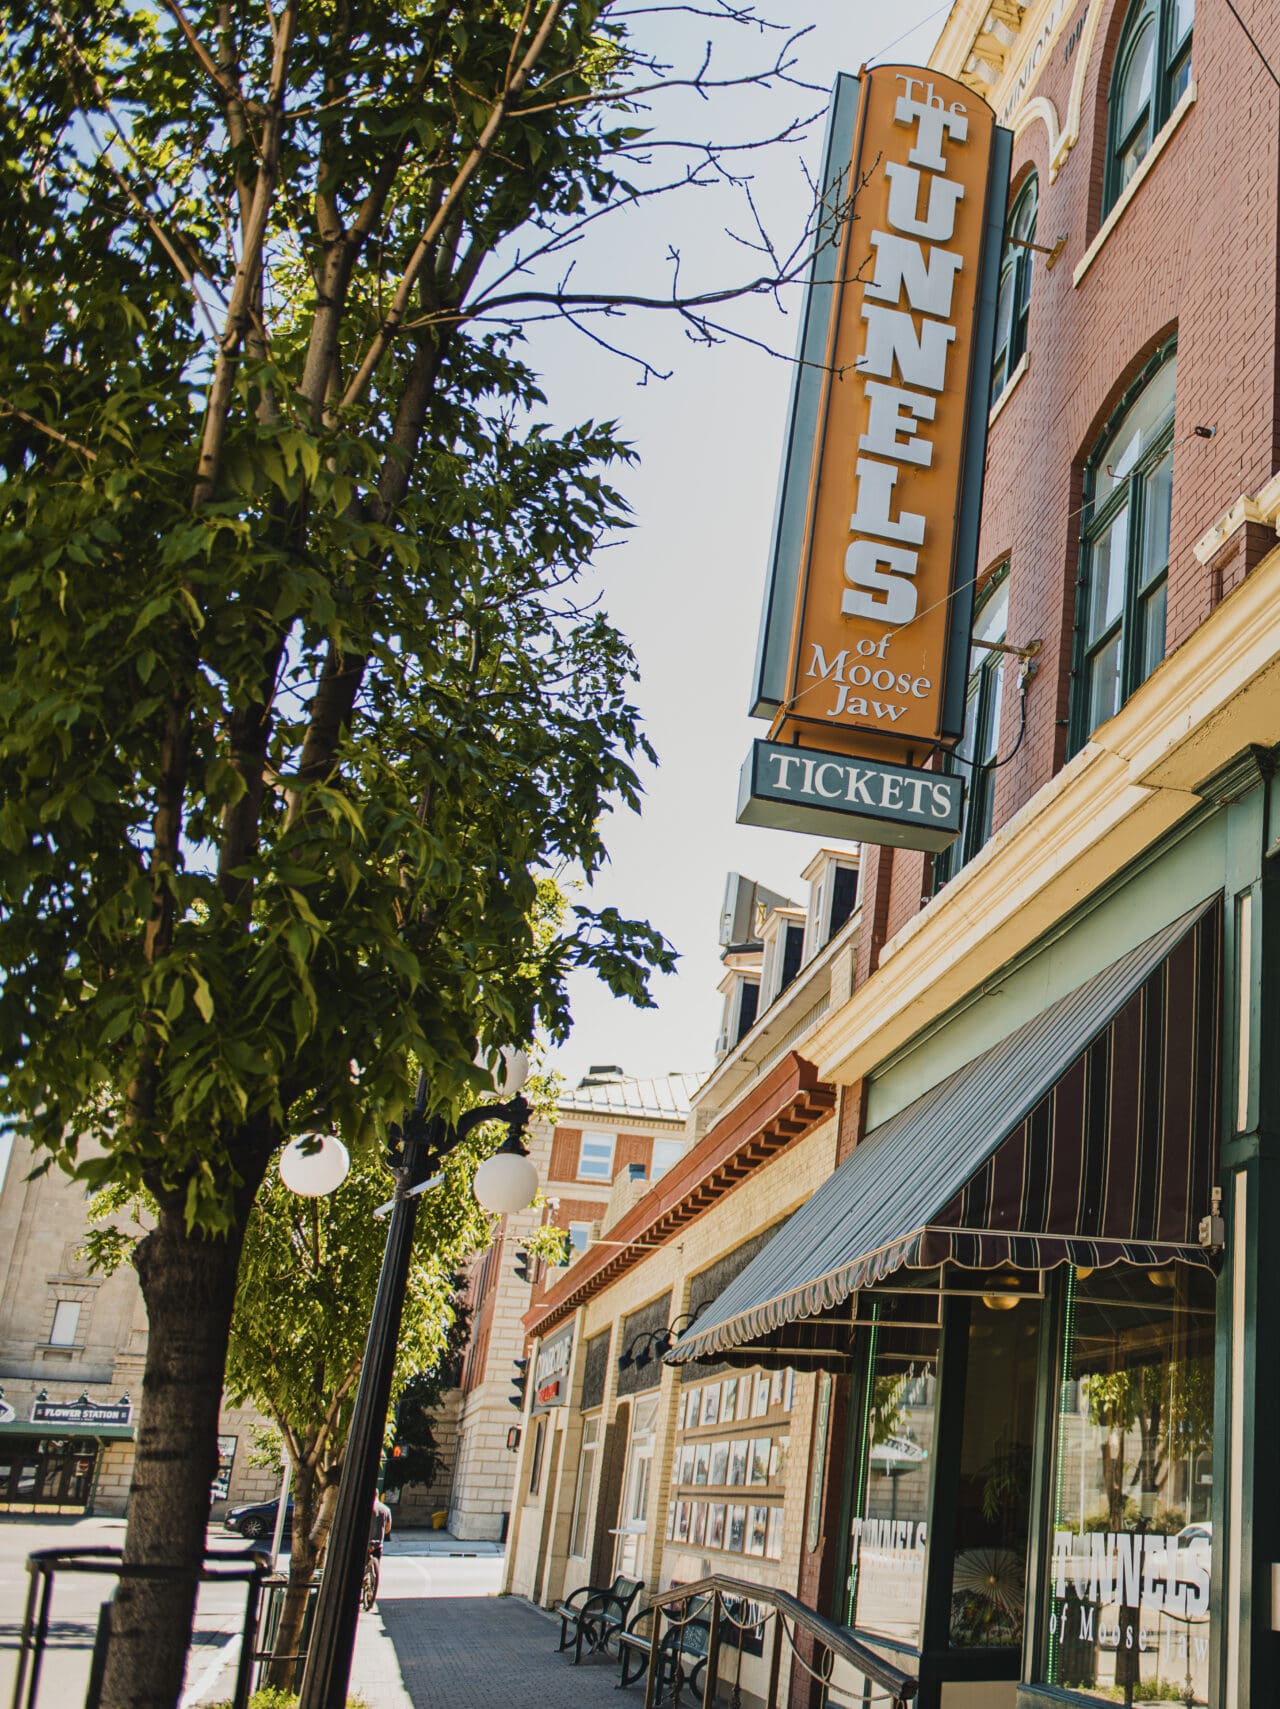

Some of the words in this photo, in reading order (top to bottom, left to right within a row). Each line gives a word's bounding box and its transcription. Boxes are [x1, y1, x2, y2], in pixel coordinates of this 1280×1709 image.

[895, 73, 968, 116] The
[839, 95, 969, 627] TUNNELS
[805, 642, 932, 700] Moose
[856, 632, 895, 660] of
[826, 684, 909, 723] Jaw
[768, 752, 952, 818] TICKETS
[44, 1408, 81, 1417] FLOWER
[83, 1410, 119, 1418] STATION
[808, 1377, 830, 1547] TUNNELS
[1052, 1530, 1212, 1618] TUNNELS
[1078, 1605, 1148, 1652] Moose
